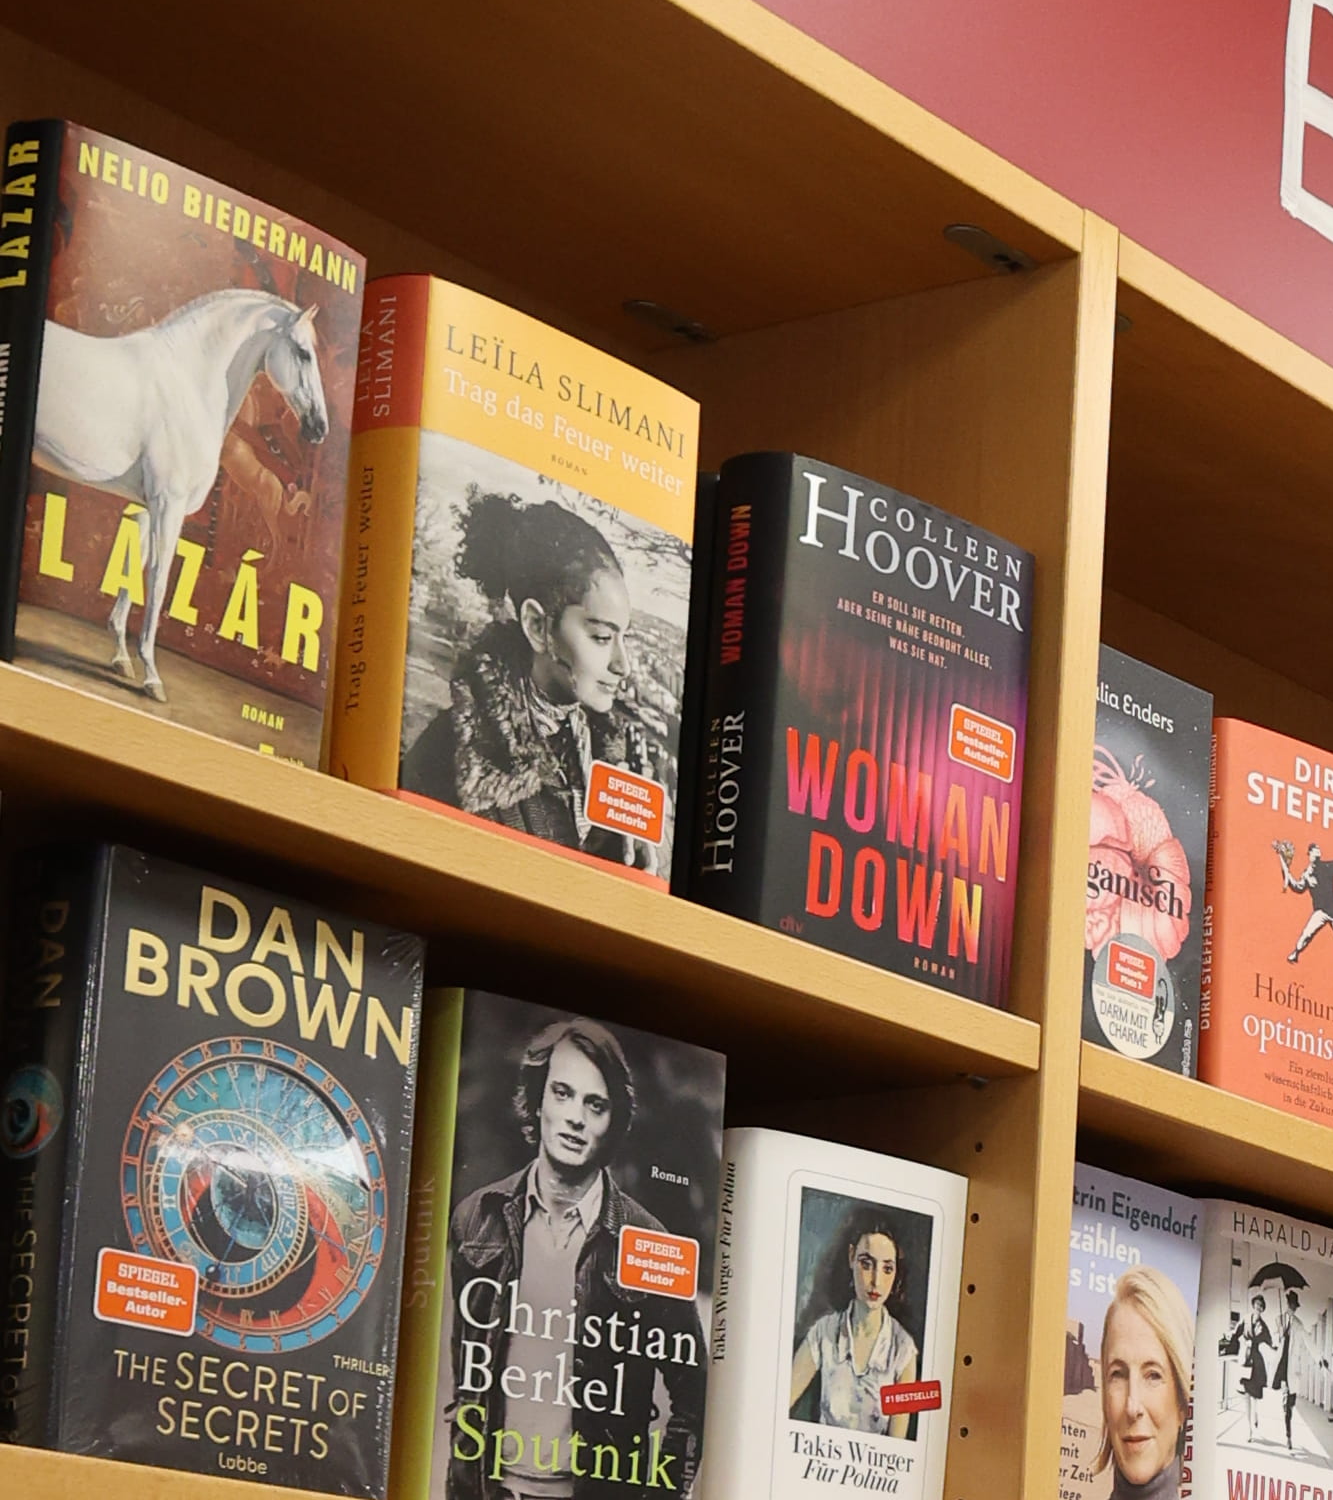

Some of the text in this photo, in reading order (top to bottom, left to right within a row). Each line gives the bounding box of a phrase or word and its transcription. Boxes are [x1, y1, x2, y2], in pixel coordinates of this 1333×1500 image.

[78, 143, 357, 294] NELIO BIEDERMANN
[373, 296, 398, 418] SLIMANI
[446, 324, 685, 460] LEÏLA SLIMANI
[444, 367, 683, 498] Trag das Feuer weiter
[551, 453, 589, 477] ROMAN
[721, 504, 752, 667] WOMAN DOWN
[242, 704, 284, 731] ROMAN
[786, 726, 1010, 883] WOMAN
[199, 885, 364, 989] DAN
[805, 829, 982, 964] DOWN
[124, 928, 414, 1067] BROWN
[913, 956, 956, 980] ROMAN
[651, 1165, 689, 1187] Roman
[1233, 1211, 1311, 1252] HARALD
[124, 1299, 169, 1321] Autor
[458, 1277, 700, 1367] Christian
[112, 1350, 367, 1420] THE SECRET OF
[458, 1339, 625, 1417] Berkel
[156, 1396, 329, 1461] SECRETS
